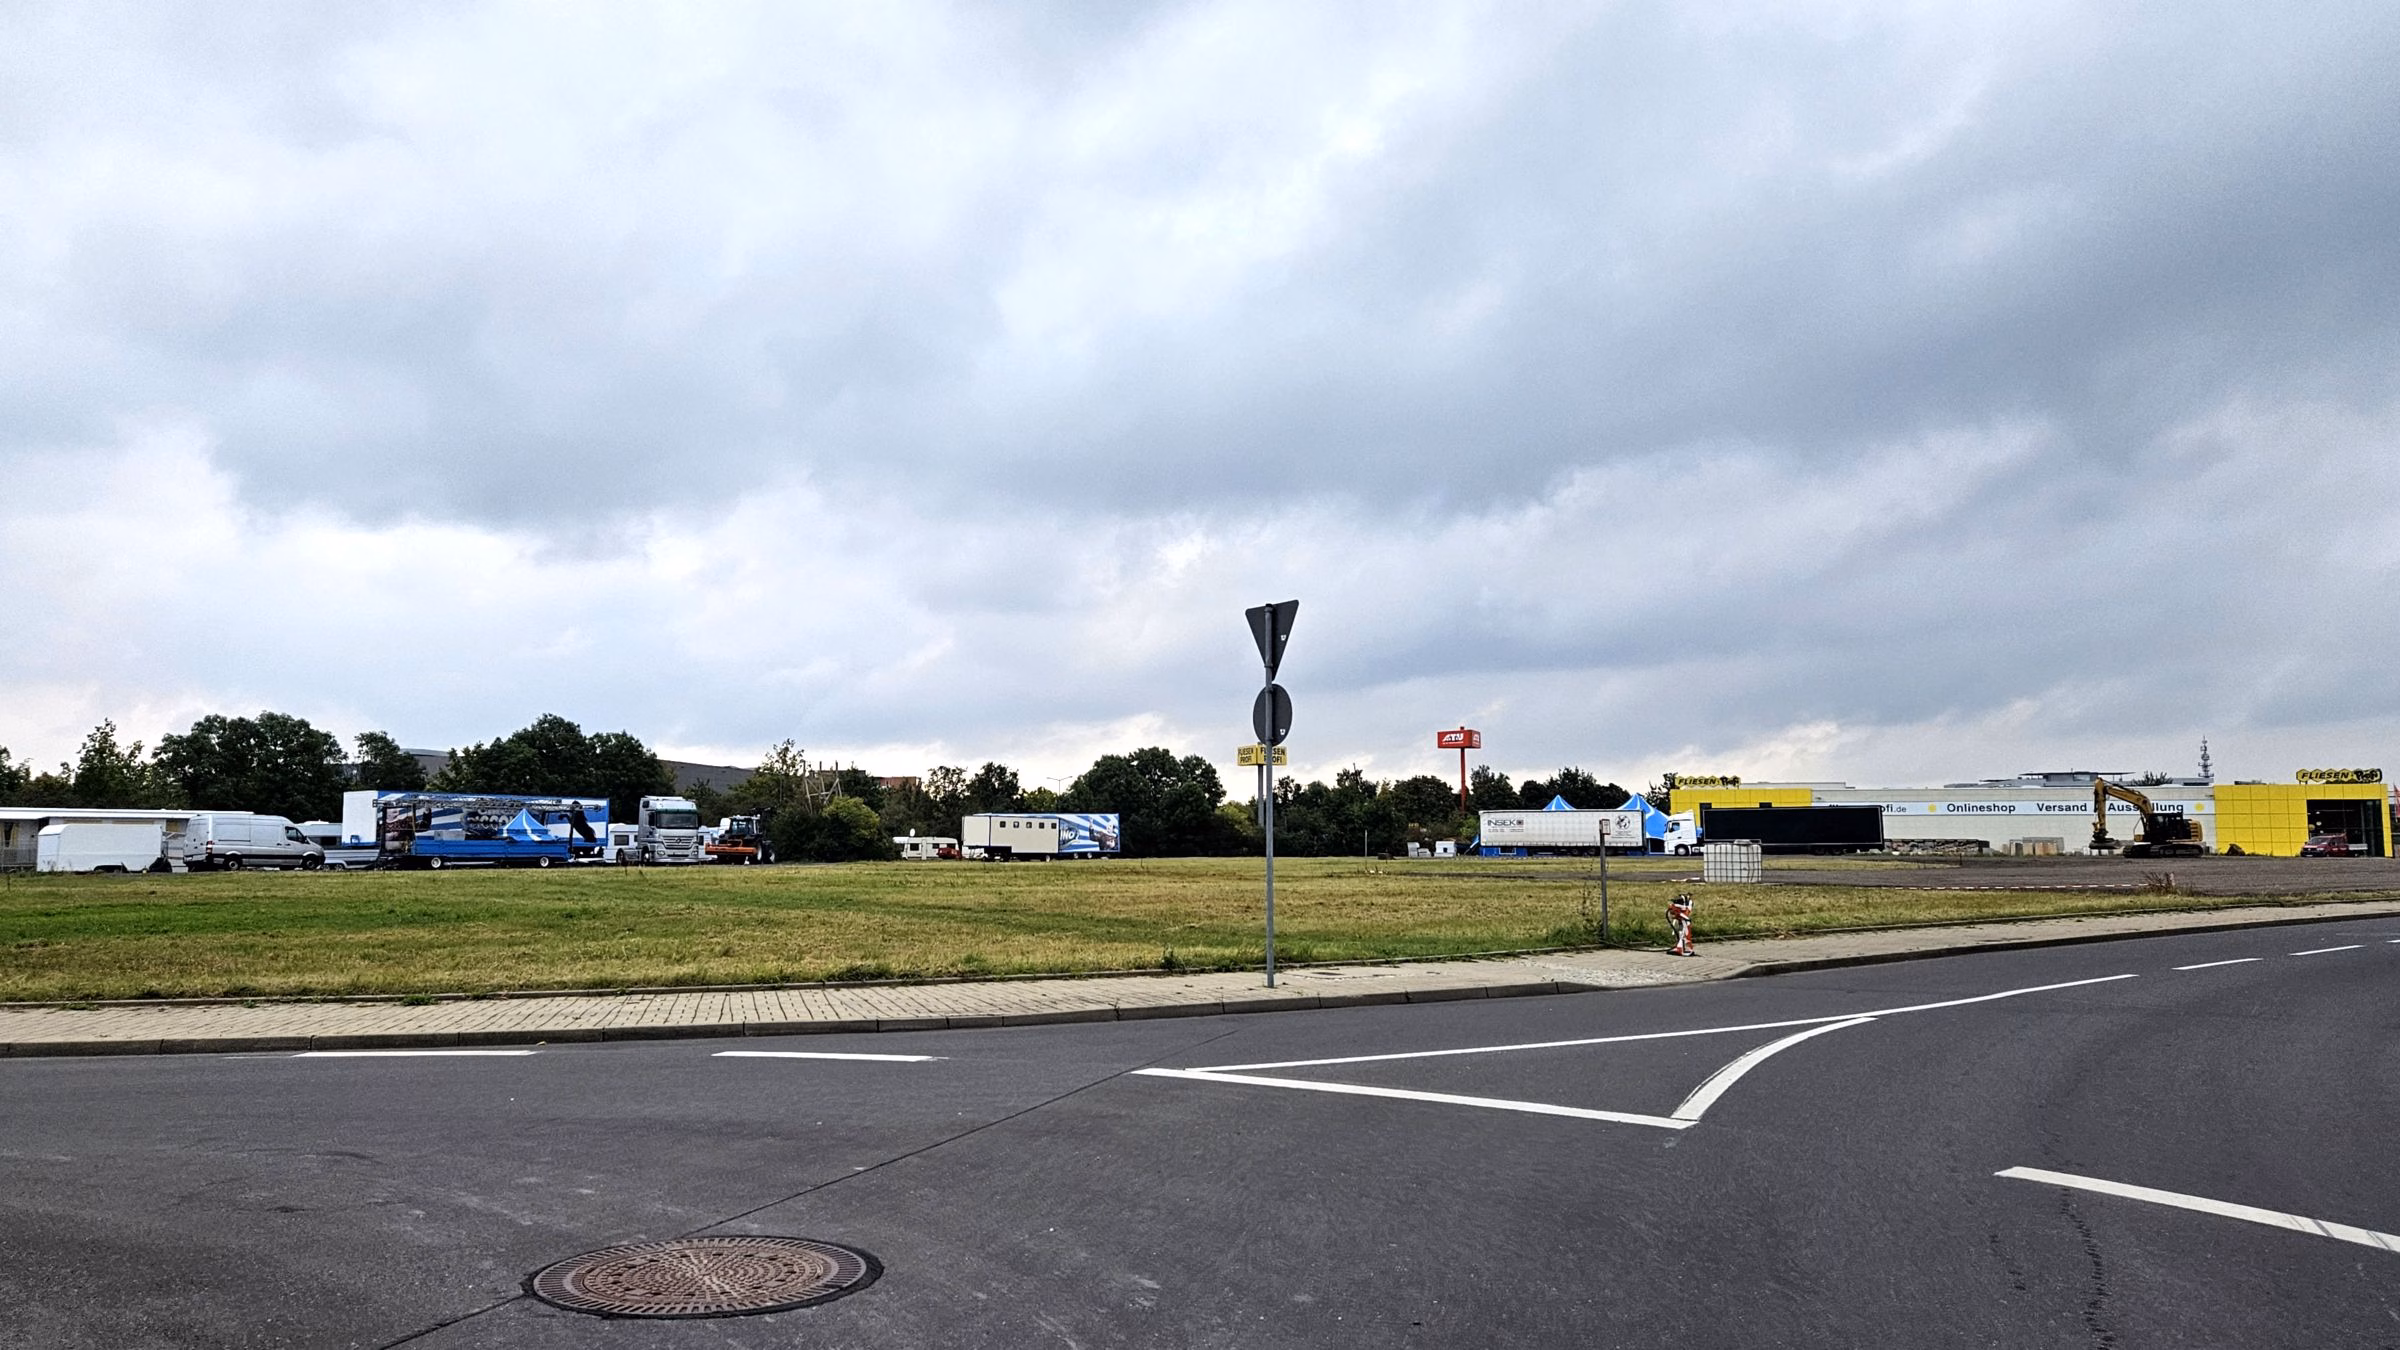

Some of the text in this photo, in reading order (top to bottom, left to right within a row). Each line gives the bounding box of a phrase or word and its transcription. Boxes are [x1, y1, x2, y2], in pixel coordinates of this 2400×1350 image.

[1260, 747, 1286, 755] FLSEN
[2301, 771, 2350, 779] FLIESEN
[1947, 803, 2016, 814] Onlineshop
[2036, 802, 2087, 812] Versand
[2107, 802, 2184, 813] Aussllung
